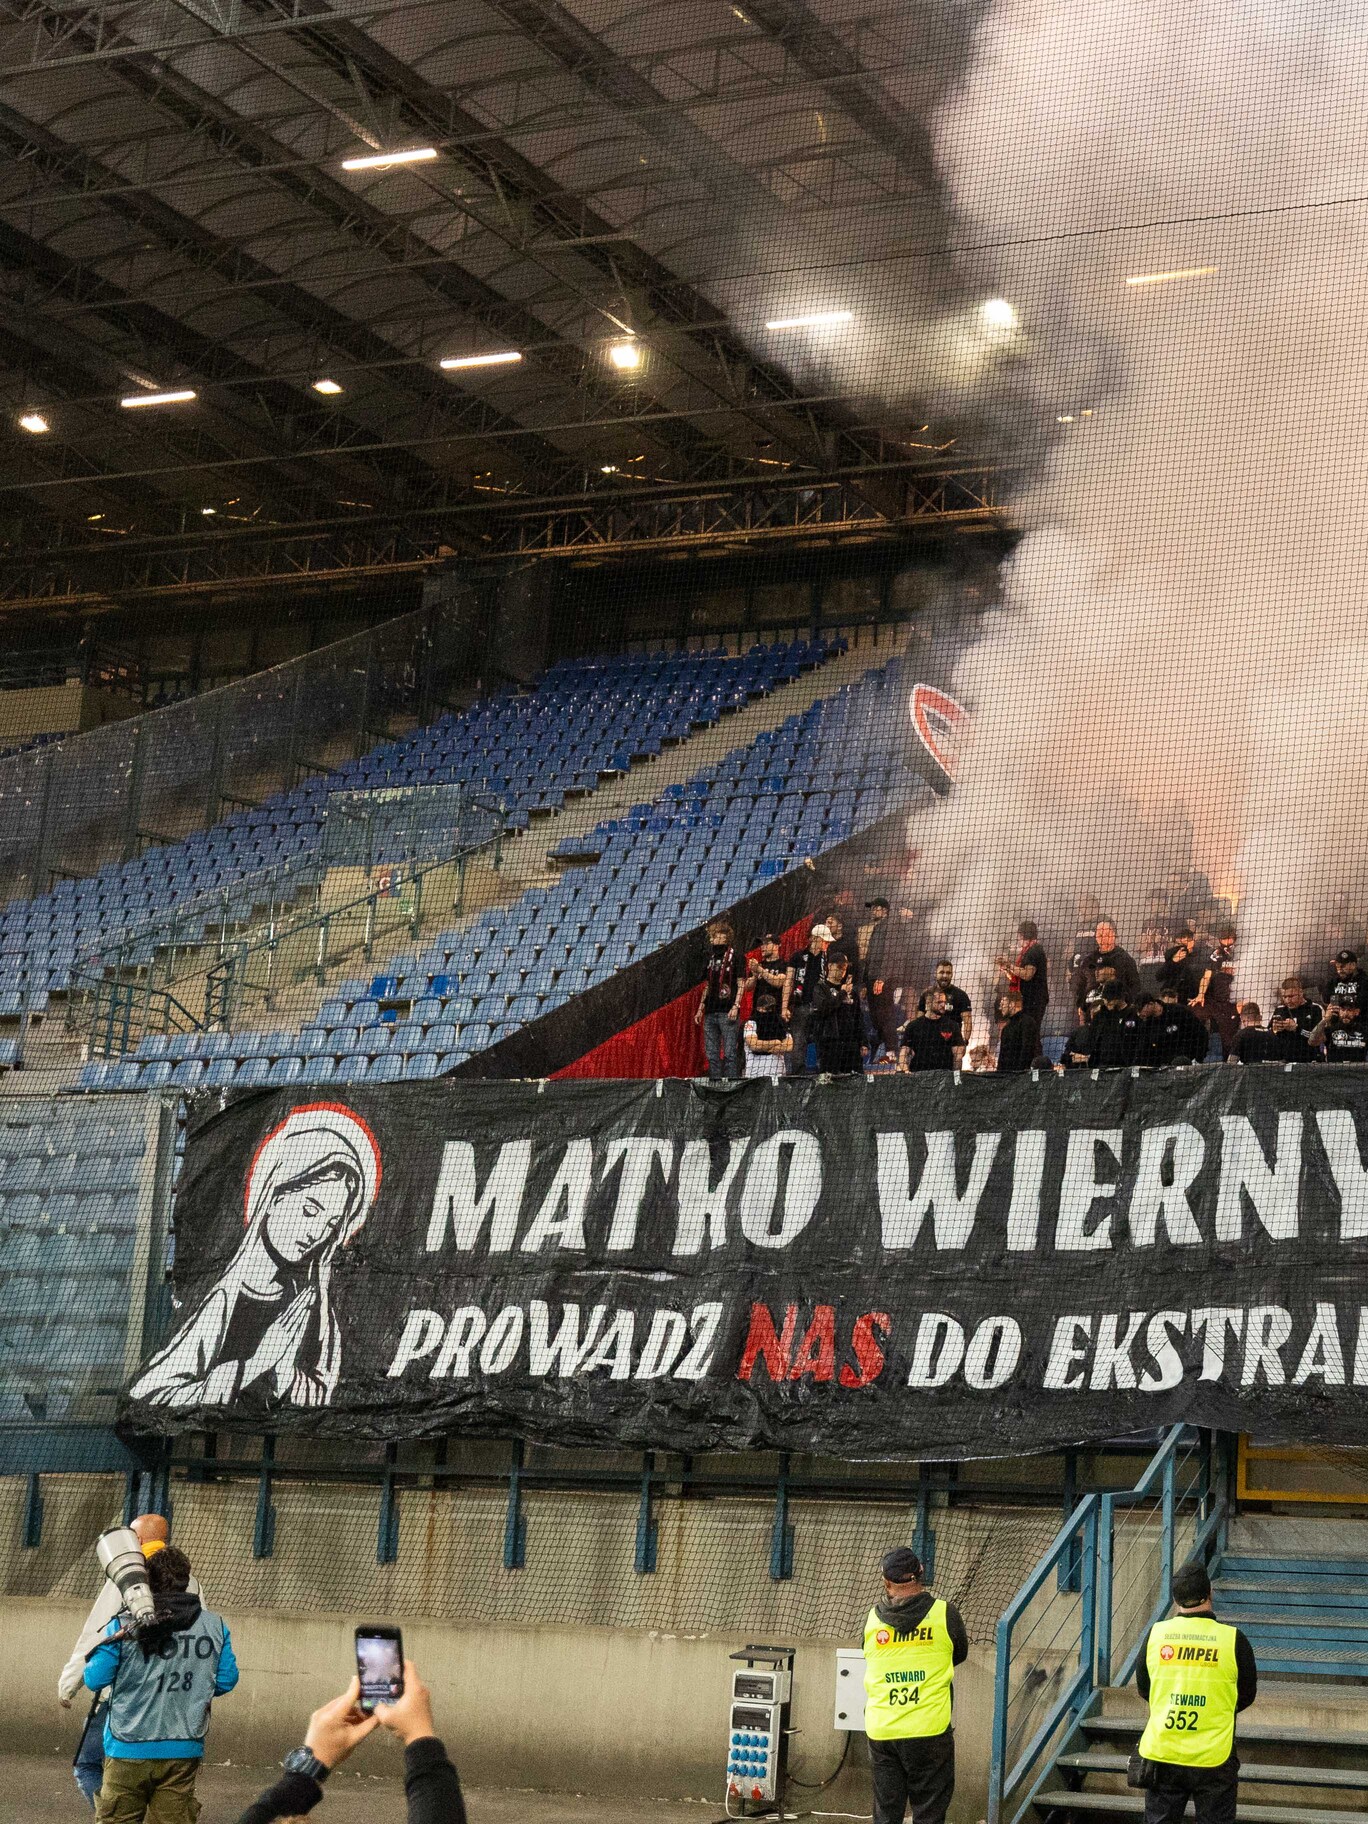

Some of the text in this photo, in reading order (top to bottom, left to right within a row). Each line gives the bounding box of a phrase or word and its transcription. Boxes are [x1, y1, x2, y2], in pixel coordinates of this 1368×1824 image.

[424, 1128, 823, 1257] MATKO
[736, 1303, 892, 1389] NAS
[906, 1311, 1023, 1390] DO
[1177, 1646, 1219, 1662] IMPEL
[157, 1671, 194, 1693] 128
[885, 1670, 926, 1683] STEWARD
[889, 1686, 920, 1706] 634
[1170, 1693, 1206, 1707] SEWARD
[1164, 1709, 1199, 1731] 552
